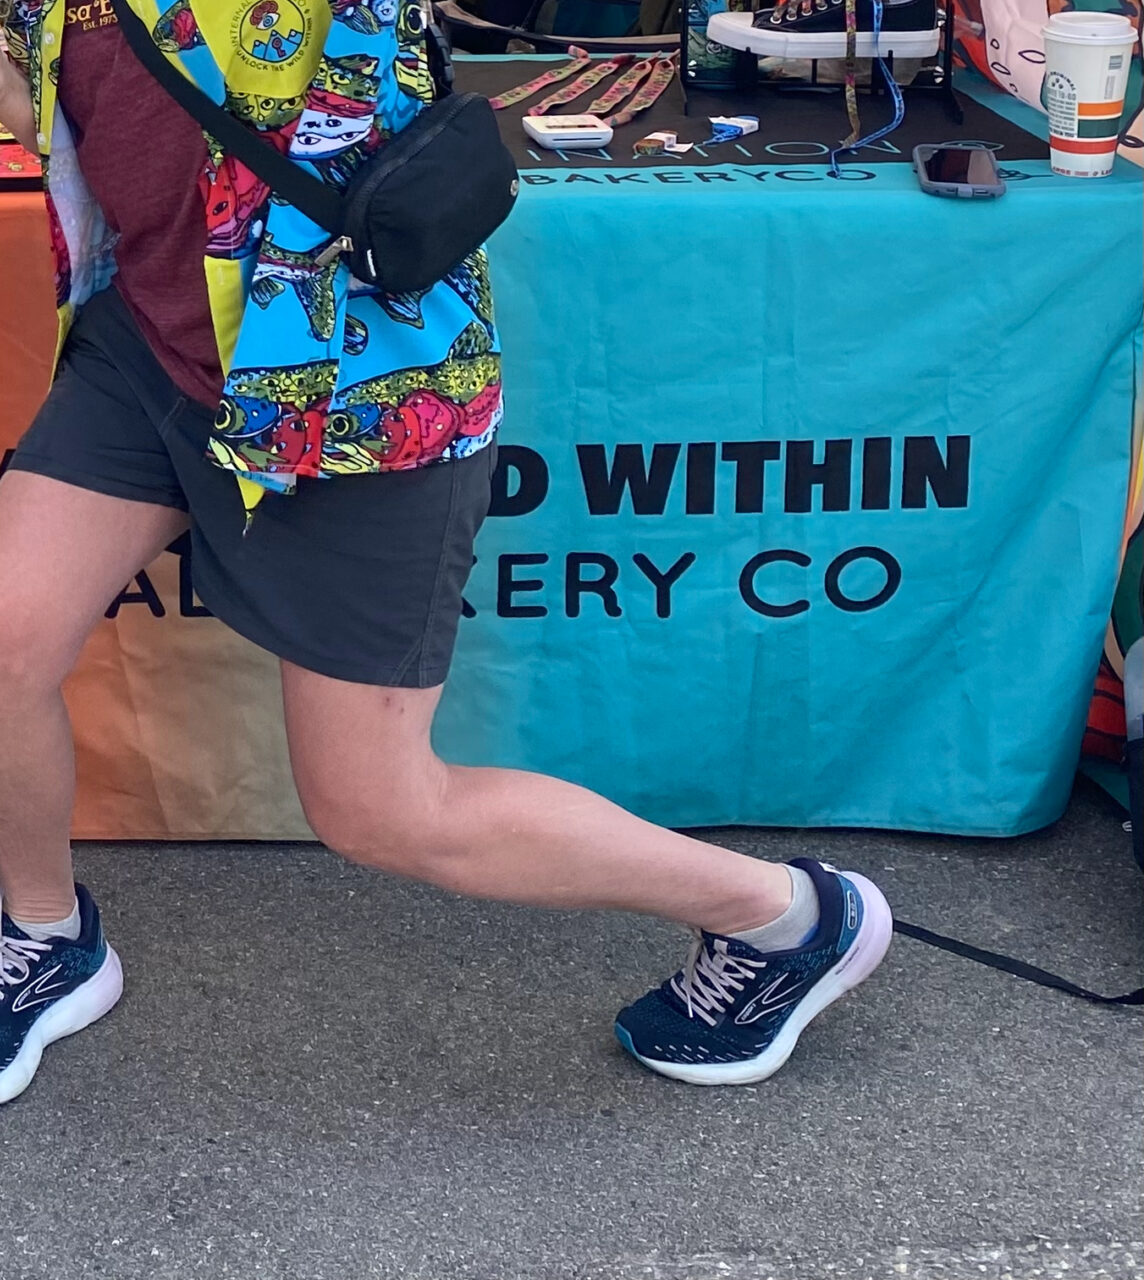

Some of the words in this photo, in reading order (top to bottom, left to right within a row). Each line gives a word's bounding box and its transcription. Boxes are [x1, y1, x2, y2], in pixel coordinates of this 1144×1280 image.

[236, 50, 269, 71] UNLOCK
[285, 49, 305, 67] WILD
[576, 435, 971, 516] WITHIN
[739, 546, 902, 618] CO
